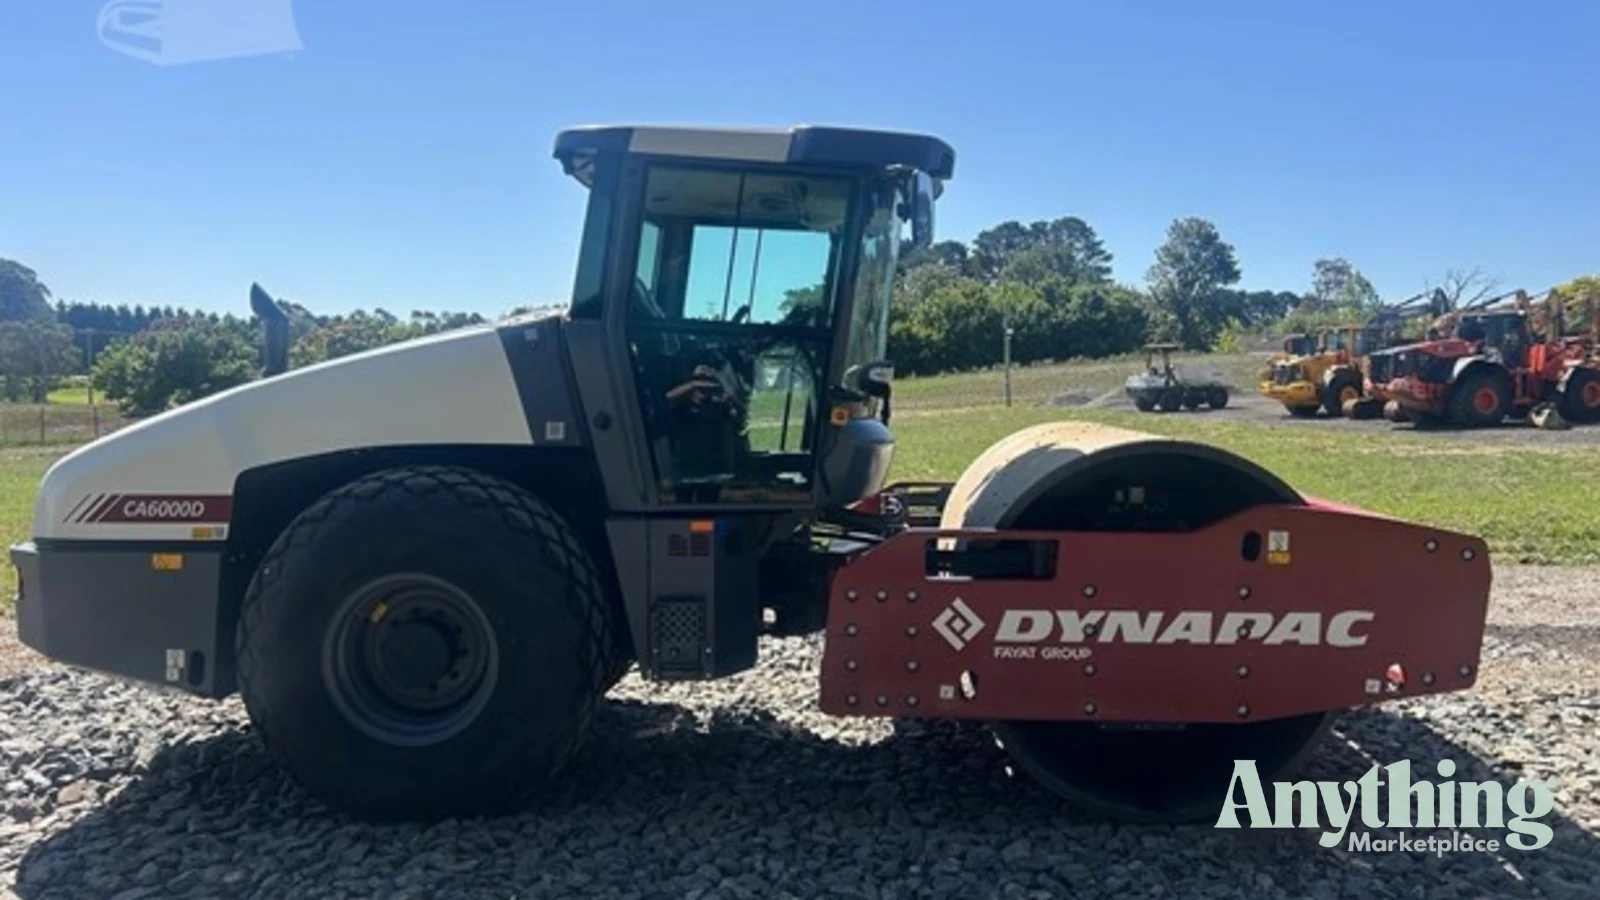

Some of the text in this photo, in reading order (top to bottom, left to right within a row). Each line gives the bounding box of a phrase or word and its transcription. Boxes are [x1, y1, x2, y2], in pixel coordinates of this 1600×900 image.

[123, 500, 205, 518] CA6000D
[994, 609, 1375, 647] DYNAPAC
[994, 648, 1092, 660] FAYAT GROUP
